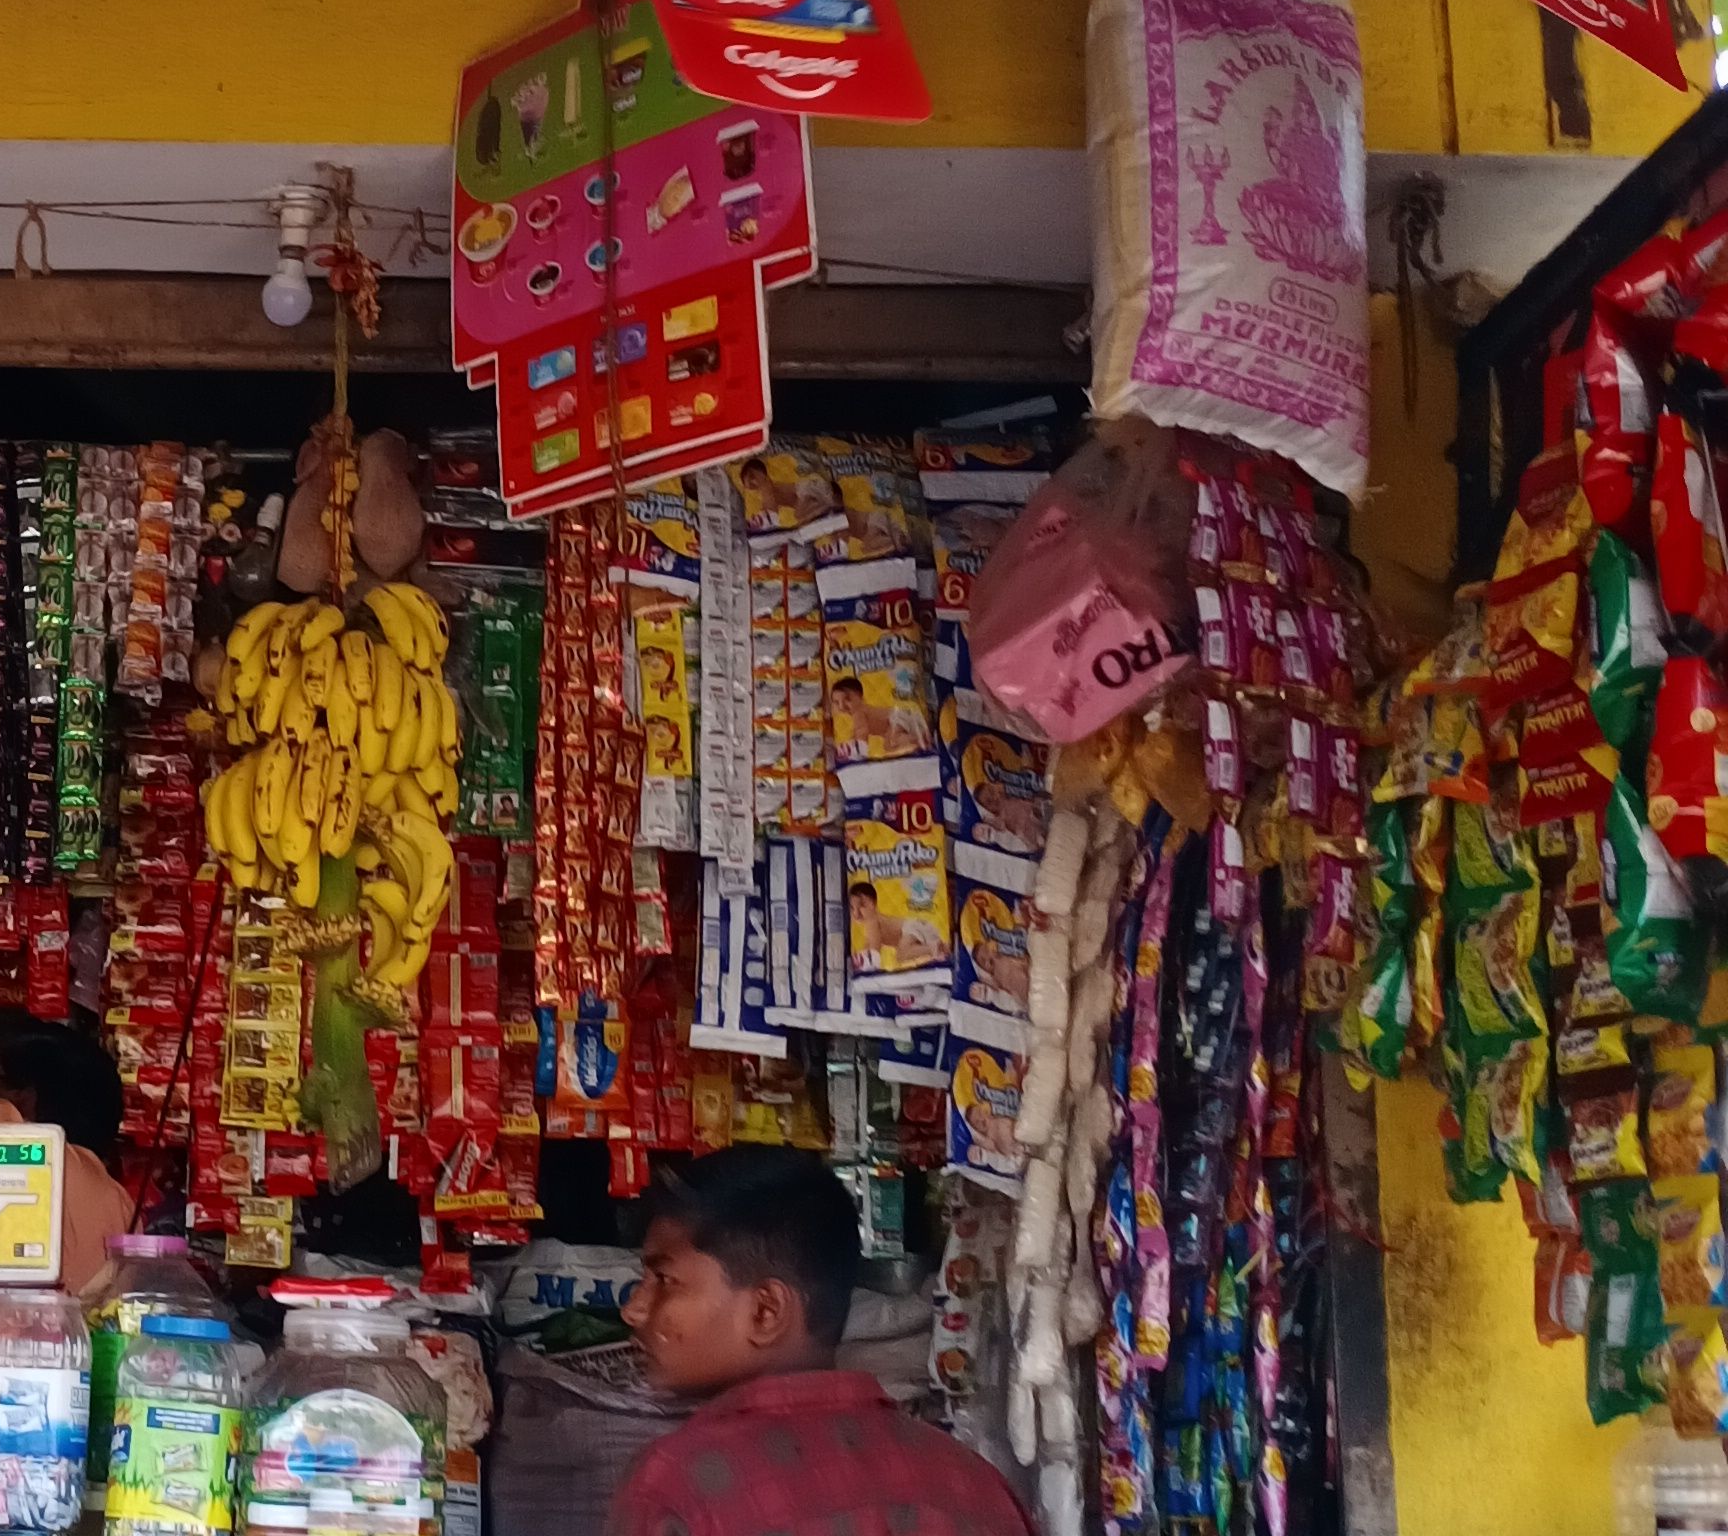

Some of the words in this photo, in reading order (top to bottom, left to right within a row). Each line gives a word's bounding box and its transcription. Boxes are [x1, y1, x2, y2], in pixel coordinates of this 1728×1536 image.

[943, 573, 965, 605] 6
[886, 600, 913, 629] 10
[901, 803, 932, 832] 10
